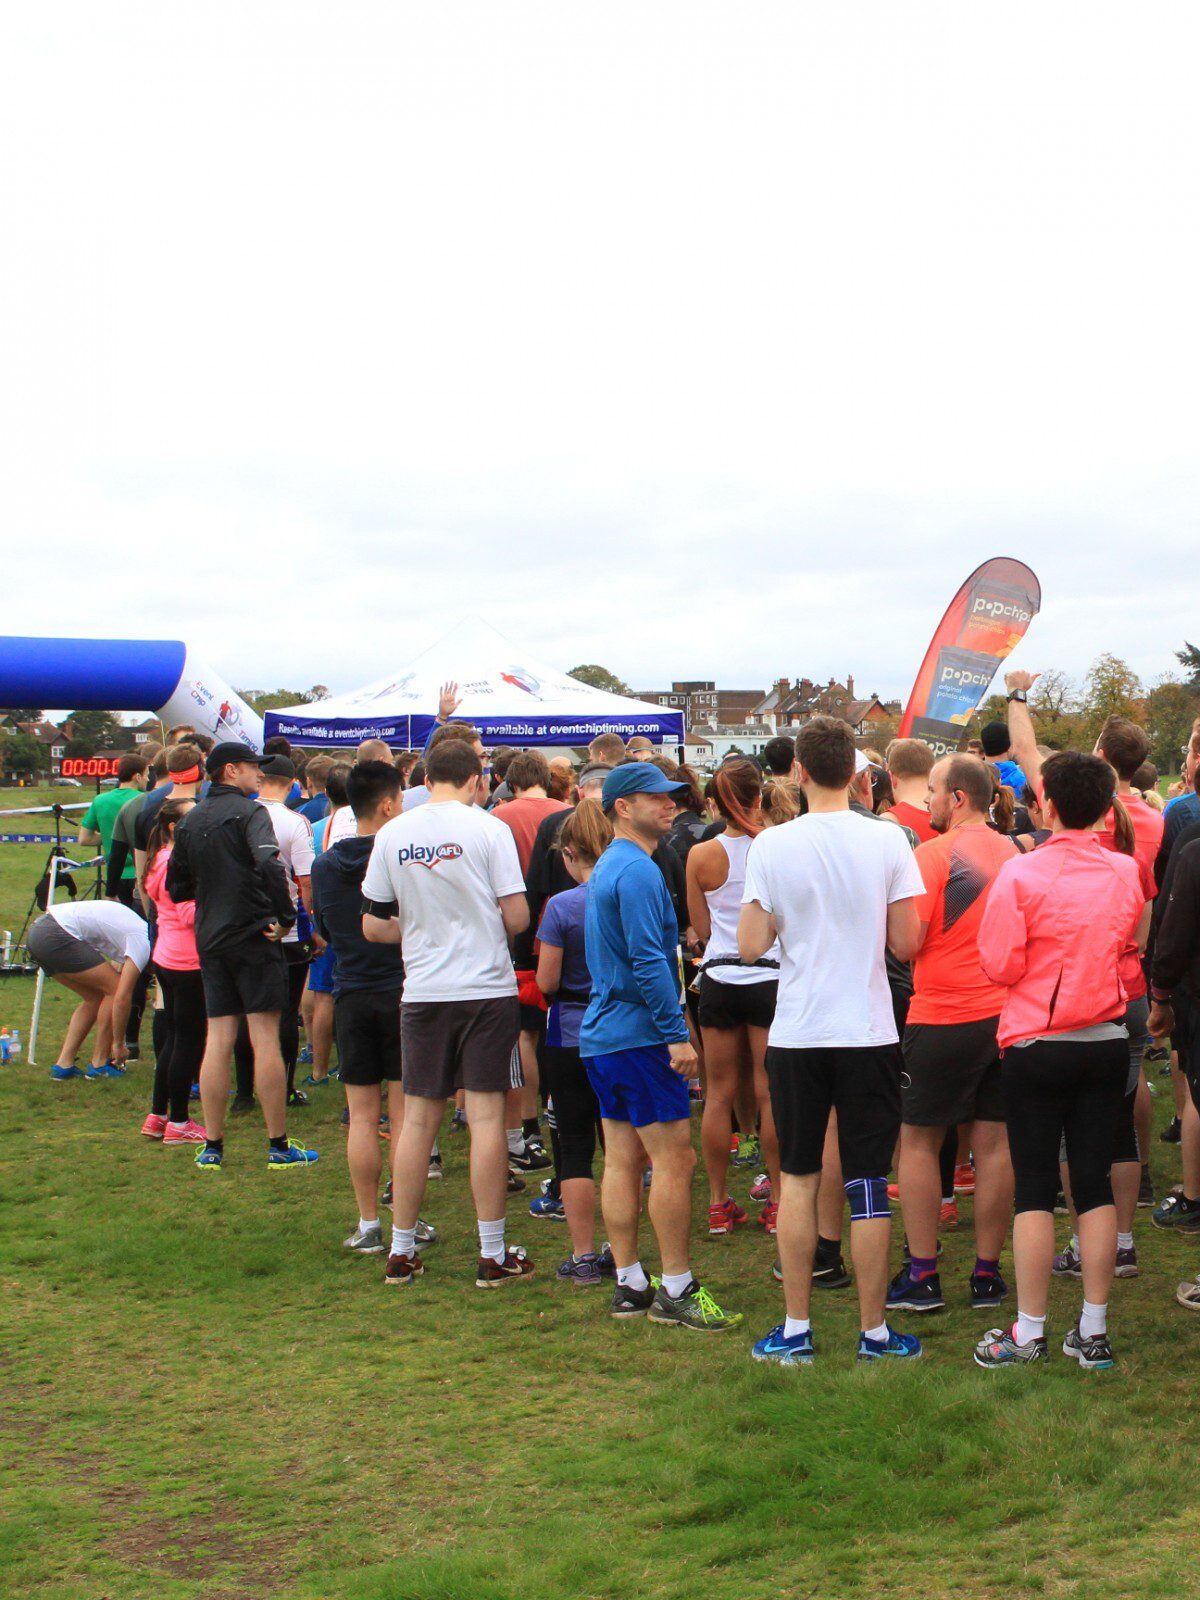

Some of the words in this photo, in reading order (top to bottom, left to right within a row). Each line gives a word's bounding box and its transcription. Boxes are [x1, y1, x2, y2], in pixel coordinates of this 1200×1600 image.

[486, 724, 534, 736] available
[536, 724, 548, 735] at
[549, 722, 660, 736] eventchiptiming.com
